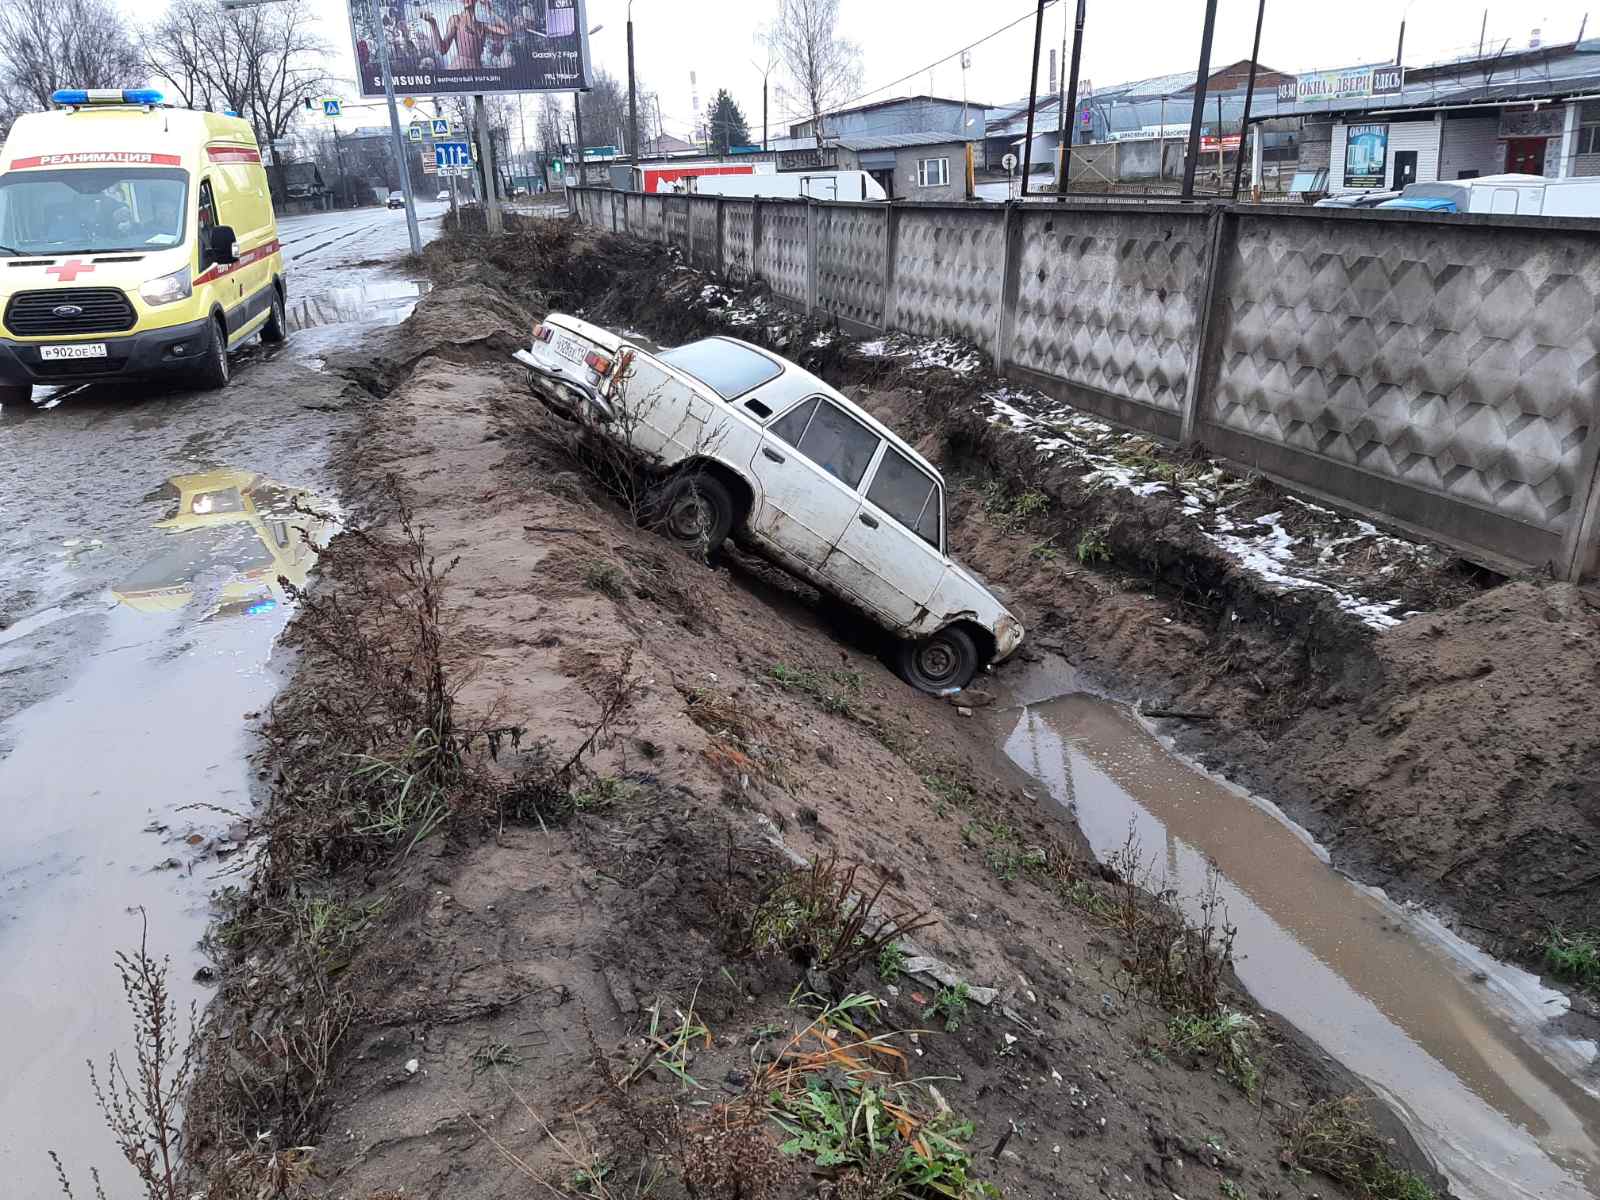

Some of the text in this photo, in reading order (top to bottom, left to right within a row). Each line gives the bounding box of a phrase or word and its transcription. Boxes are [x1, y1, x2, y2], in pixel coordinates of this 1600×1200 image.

[1298, 79, 1328, 96] ОКНА
[1334, 75, 1373, 94] ДВЕРИ
[1374, 72, 1401, 90] ЗДЕСЬ
[40, 153, 152, 165] РЕАНИМАЦИЯ
